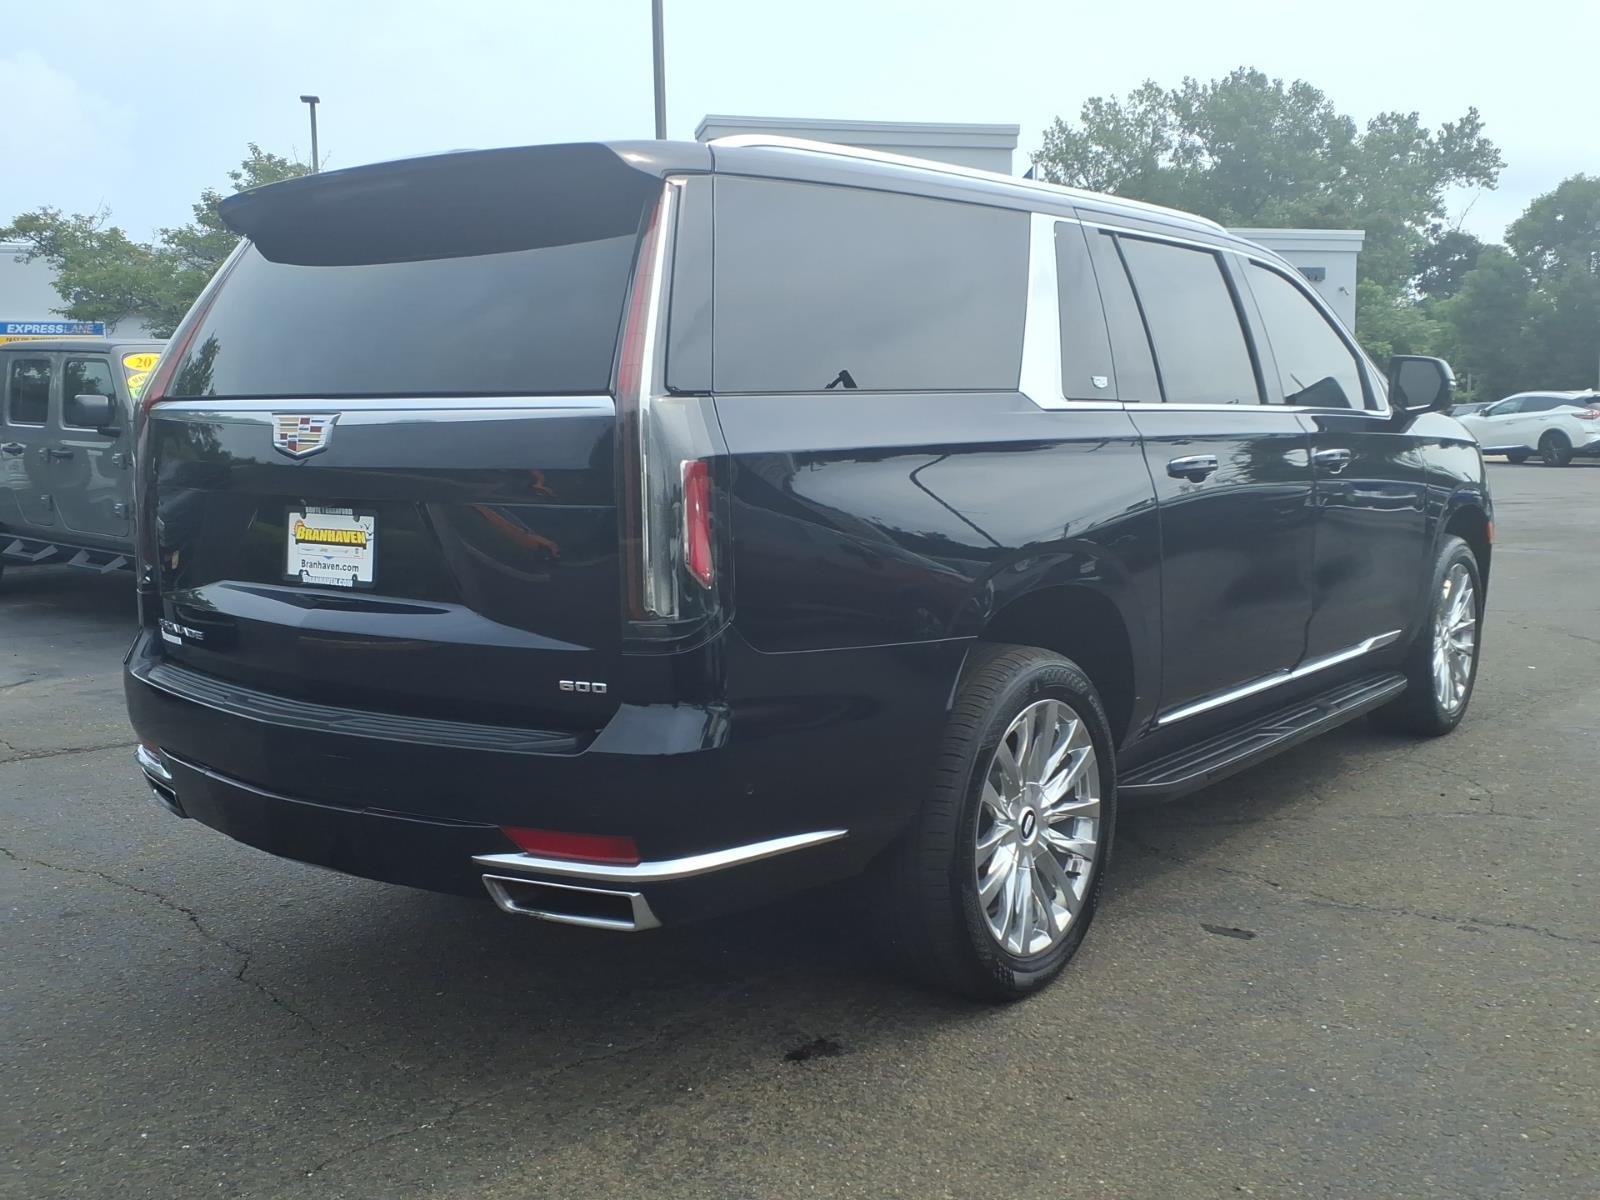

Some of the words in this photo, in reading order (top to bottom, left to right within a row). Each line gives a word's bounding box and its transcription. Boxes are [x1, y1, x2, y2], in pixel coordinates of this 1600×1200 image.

[296, 526, 366, 544] BRANHAVEN
[301, 559, 359, 572] Branhaven.com
[559, 680, 607, 693] 600
